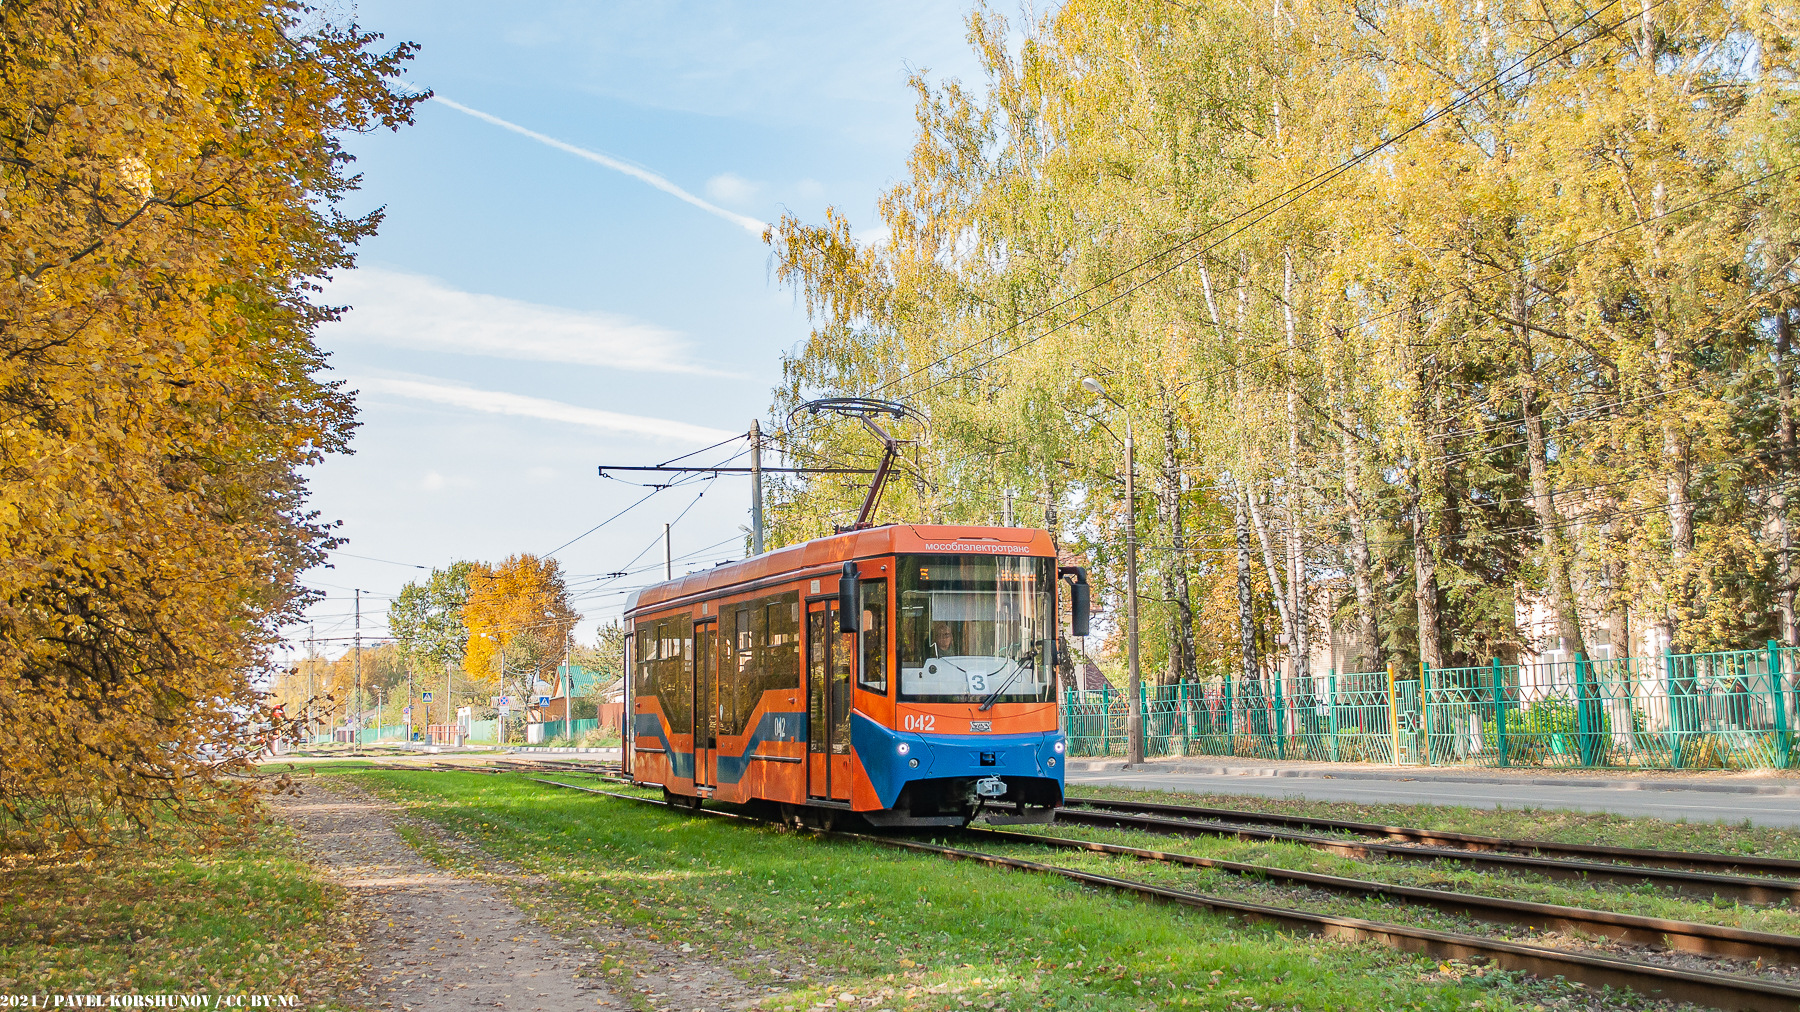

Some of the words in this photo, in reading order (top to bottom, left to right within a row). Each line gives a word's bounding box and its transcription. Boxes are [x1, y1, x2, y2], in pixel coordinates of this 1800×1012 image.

[925, 542, 1030, 553] мособлэлектротранс
[971, 674, 986, 691] 3
[774, 716, 786, 738] 042
[904, 714, 935, 731] 042
